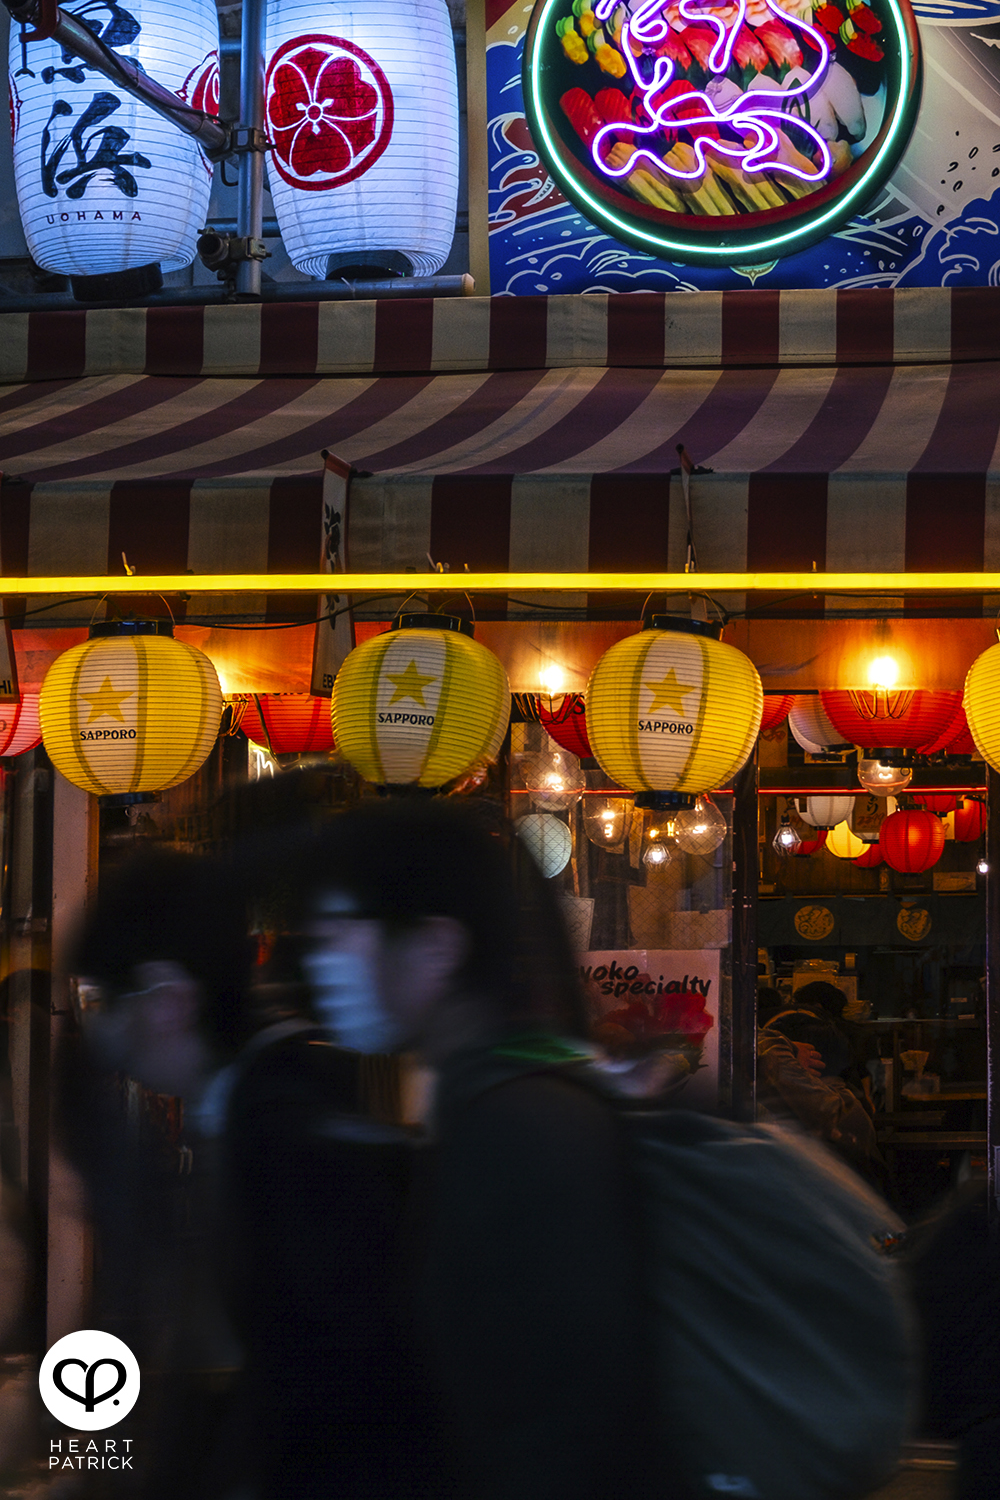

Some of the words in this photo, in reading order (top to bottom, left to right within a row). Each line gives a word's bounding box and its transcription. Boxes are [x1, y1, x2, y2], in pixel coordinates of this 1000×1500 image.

[46, 210, 142, 225] UOHAMA
[377, 711, 435, 727] SAPPORO
[637, 719, 694, 735] SAPPORO
[79, 728, 137, 741] SAPPORO
[601, 975, 711, 997] specialty
